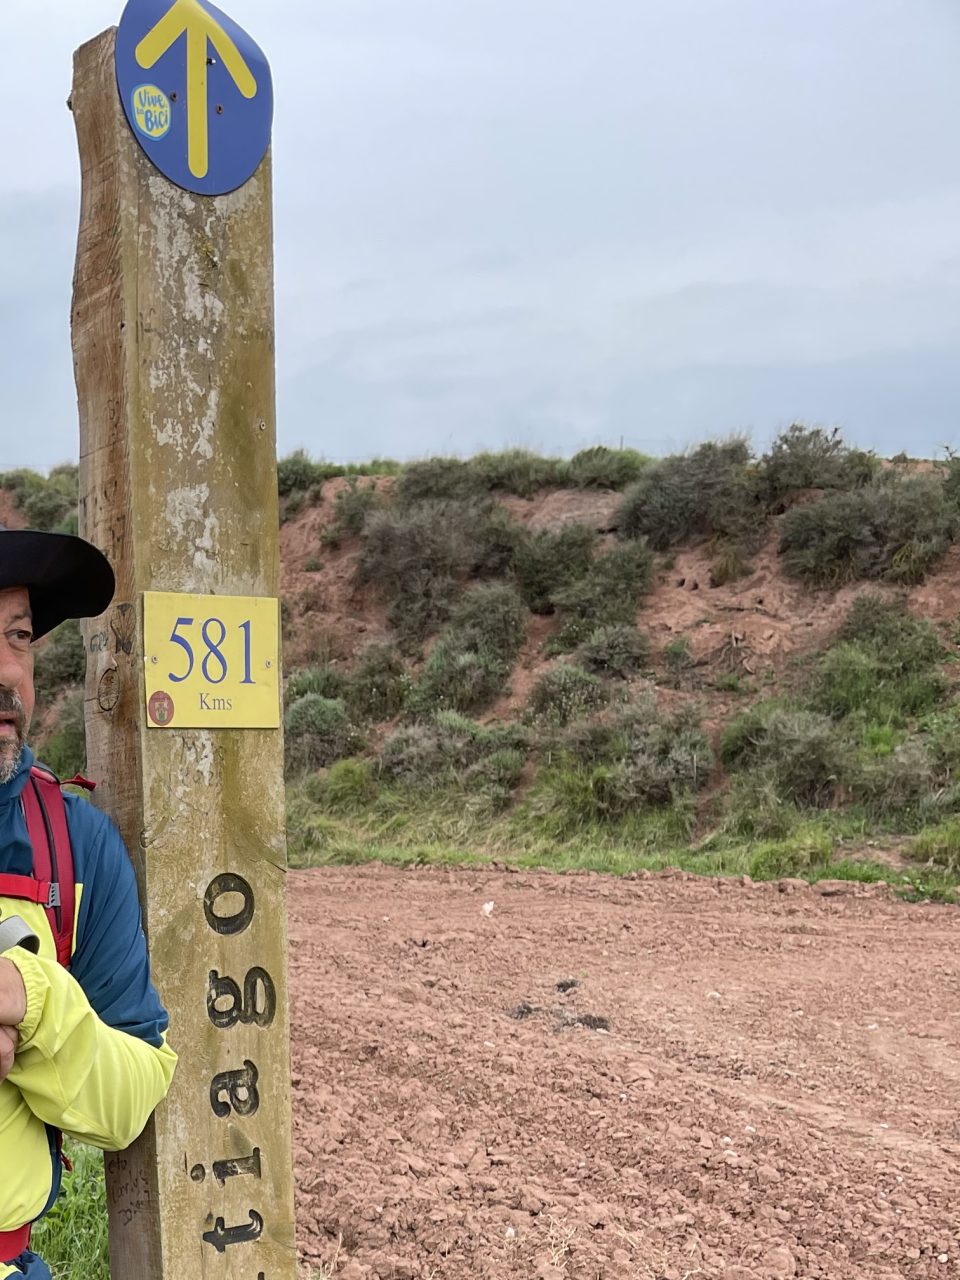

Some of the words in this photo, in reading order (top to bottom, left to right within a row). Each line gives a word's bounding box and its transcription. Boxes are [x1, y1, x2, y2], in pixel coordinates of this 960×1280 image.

[138, 90, 163, 108] Vive
[168, 617, 256, 684] 581
[199, 693, 233, 710] Kms
